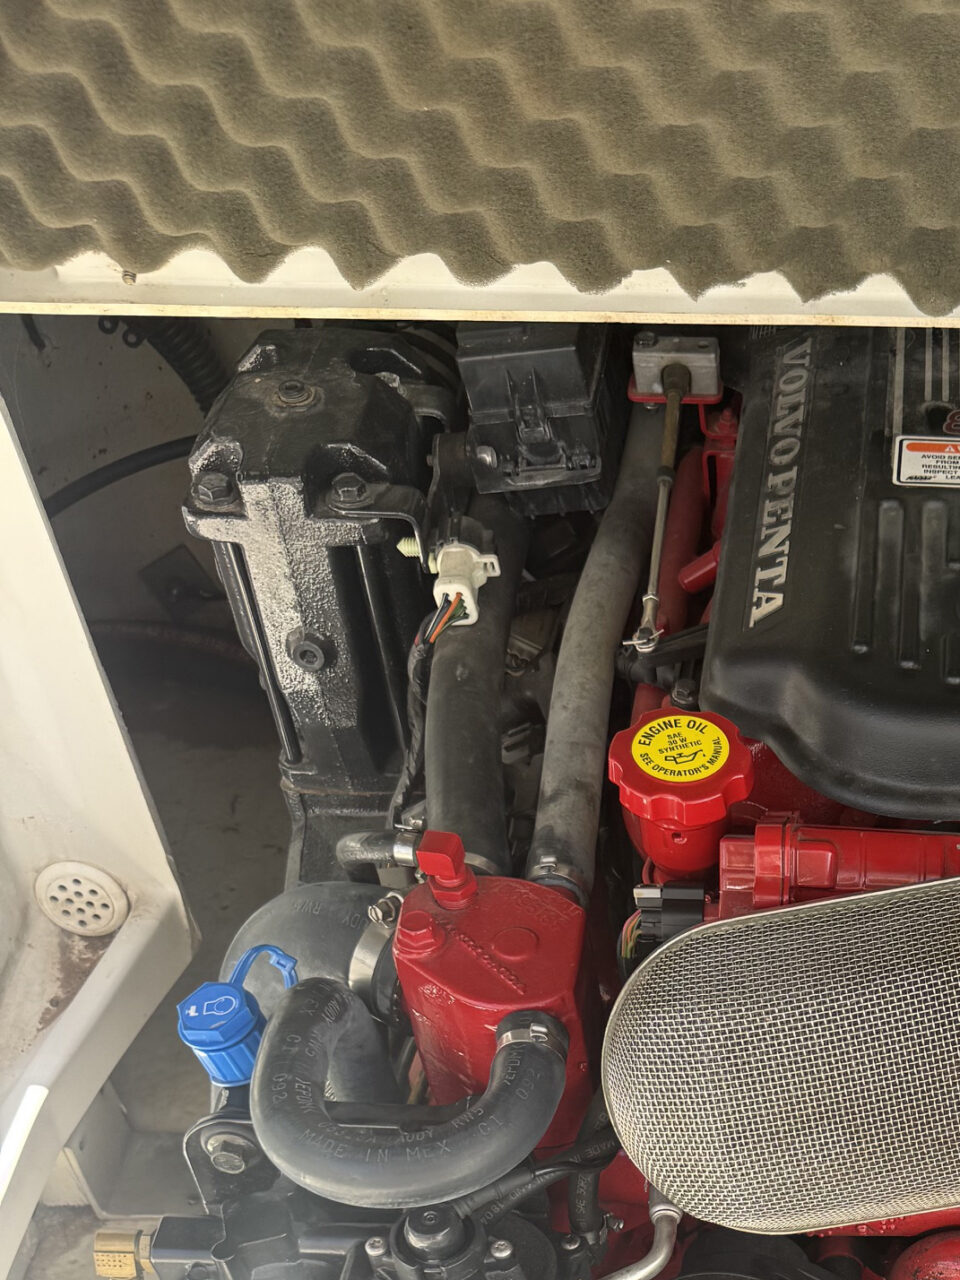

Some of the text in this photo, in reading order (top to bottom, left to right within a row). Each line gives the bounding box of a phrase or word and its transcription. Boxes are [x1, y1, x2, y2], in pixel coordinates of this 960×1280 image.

[749, 336, 813, 628] VOLVO PENTA
[638, 718, 708, 747] ENGINE OIL
[657, 739, 703, 754] SYNTHETIC
[667, 732, 683, 740] SAE
[639, 736, 723, 777] SEE OPERATOR'S MANUAL
[299, 1128, 348, 1160] MADE
[366, 1148, 389, 1163] IN
[405, 1139, 451, 1162] MEX
